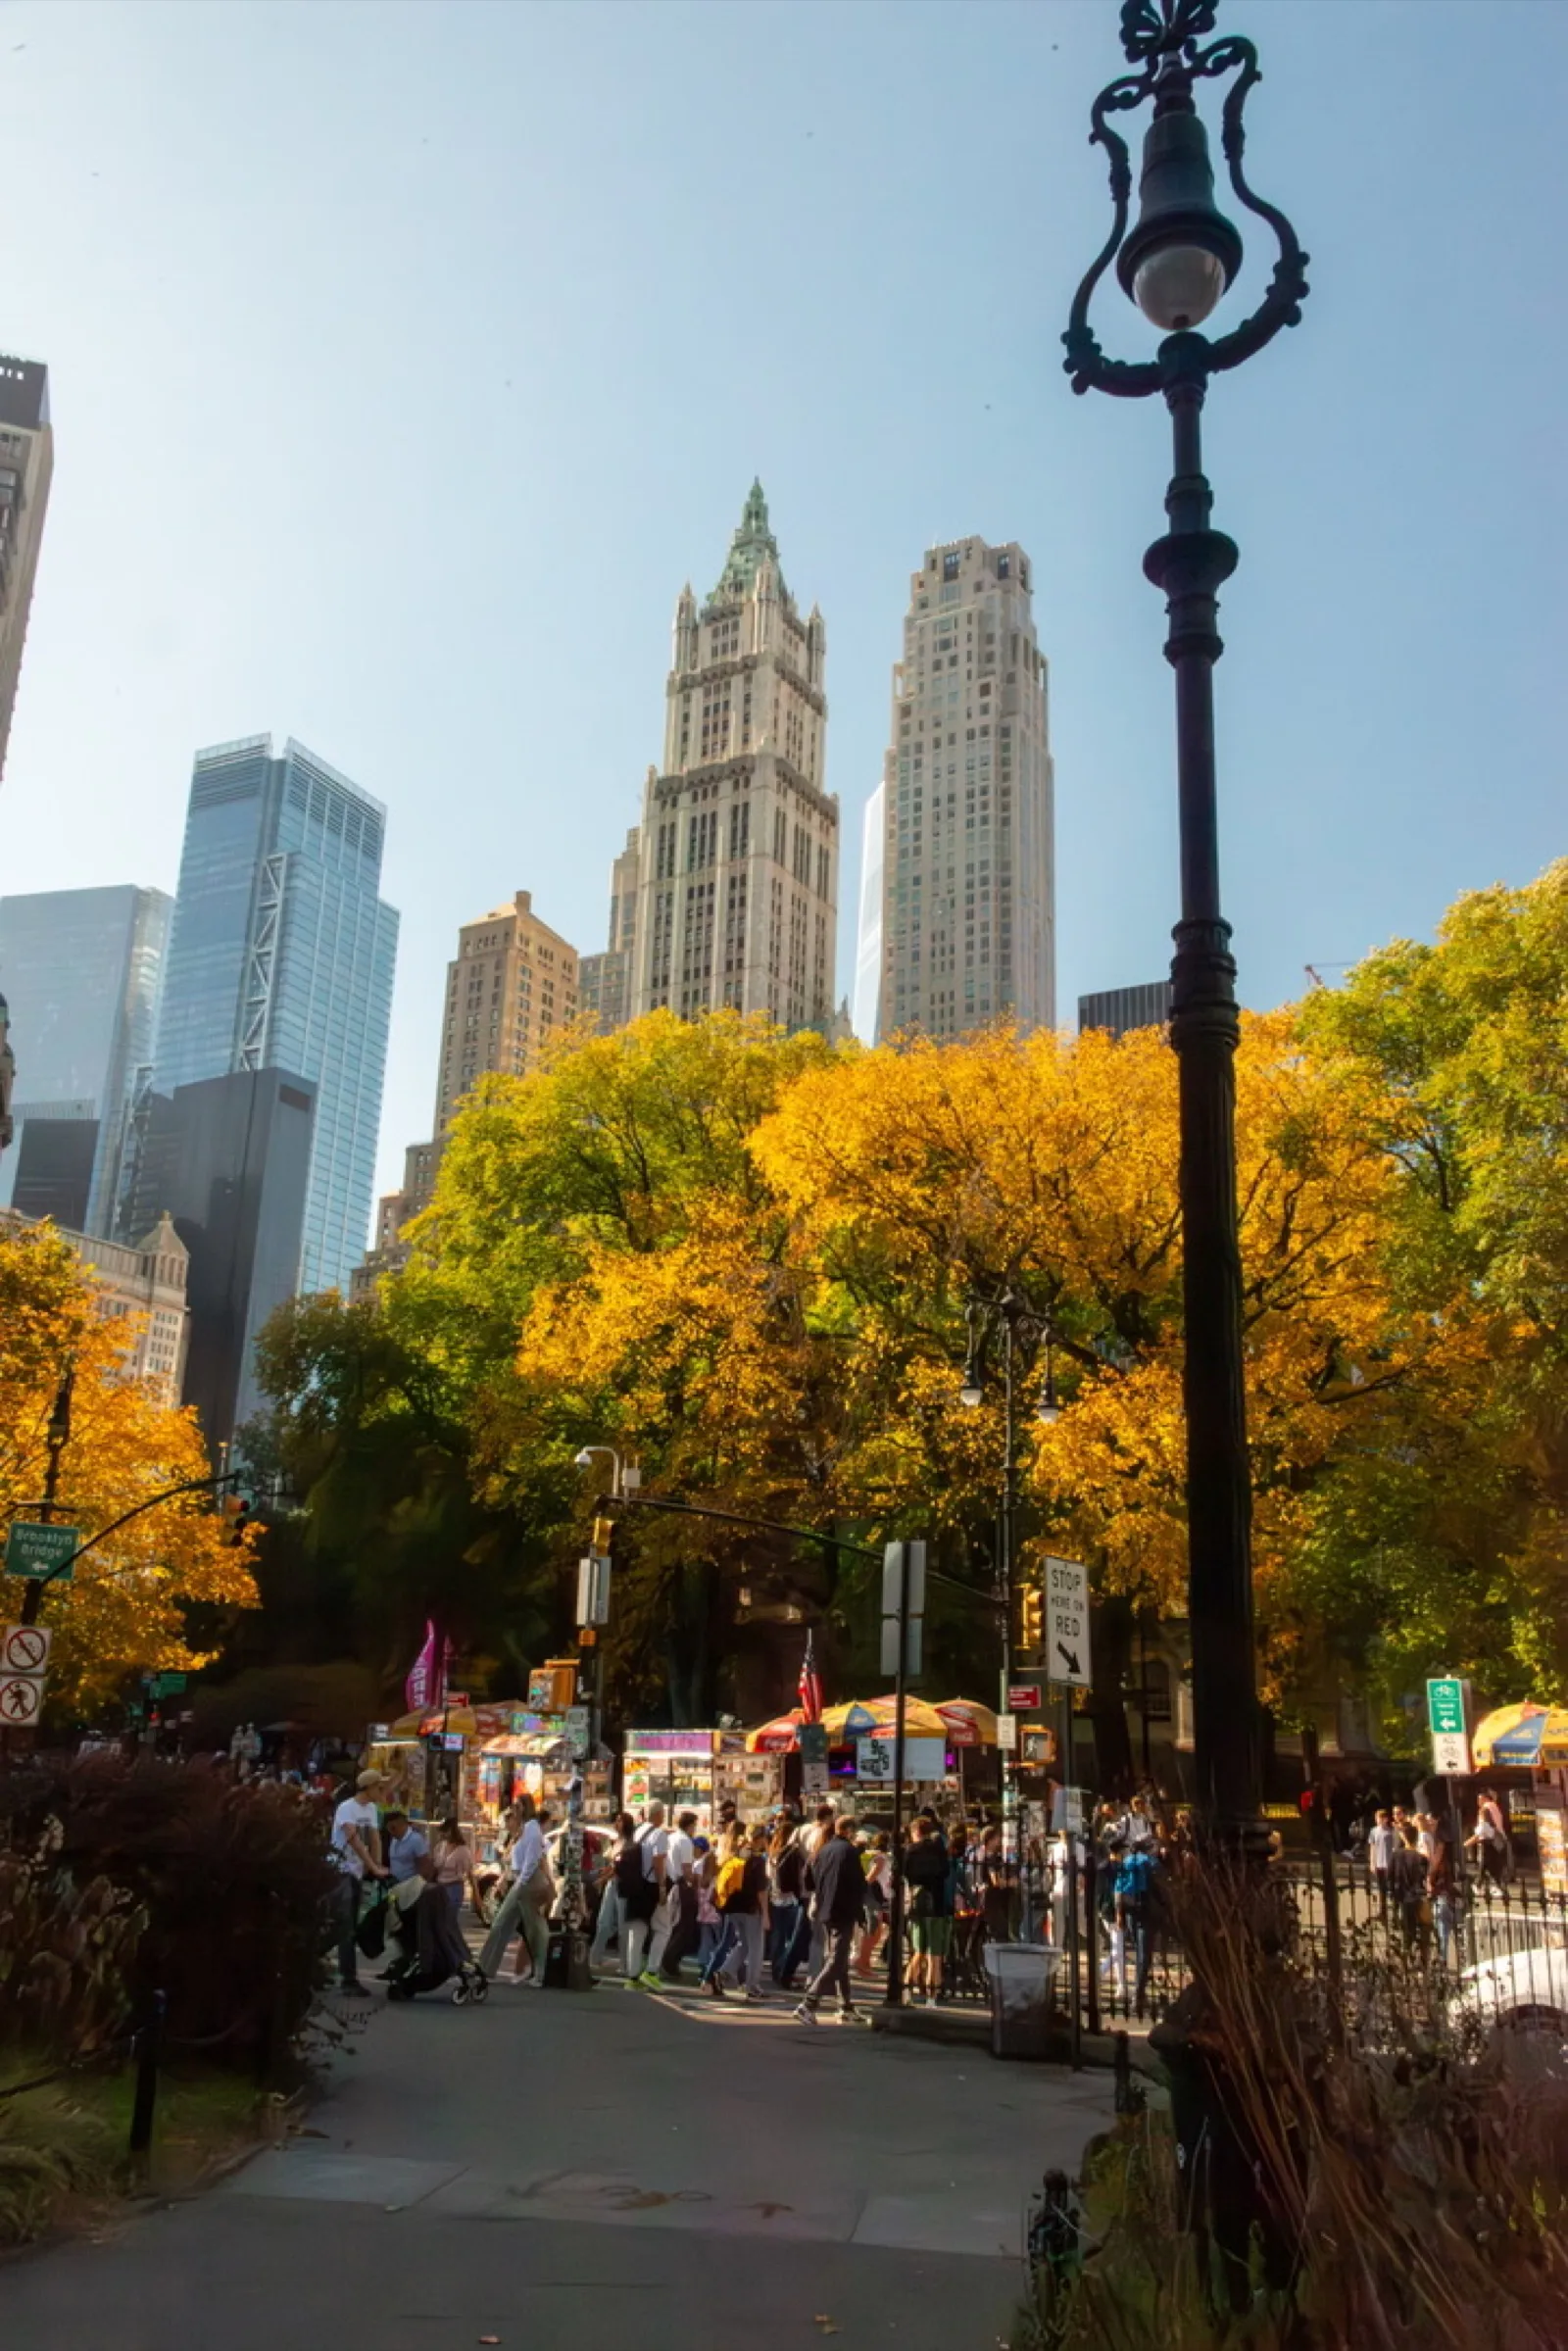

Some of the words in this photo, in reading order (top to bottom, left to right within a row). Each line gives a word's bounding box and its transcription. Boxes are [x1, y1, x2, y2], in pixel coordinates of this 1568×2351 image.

[16, 1528, 73, 1545] Brooklyn
[22, 1543, 63, 1560] Bridge
[1052, 1568, 1081, 1592] STOP
[1051, 1594, 1070, 1609] HERE
[1073, 1598, 1085, 1611] ON
[1055, 1615, 1081, 1638] RED
